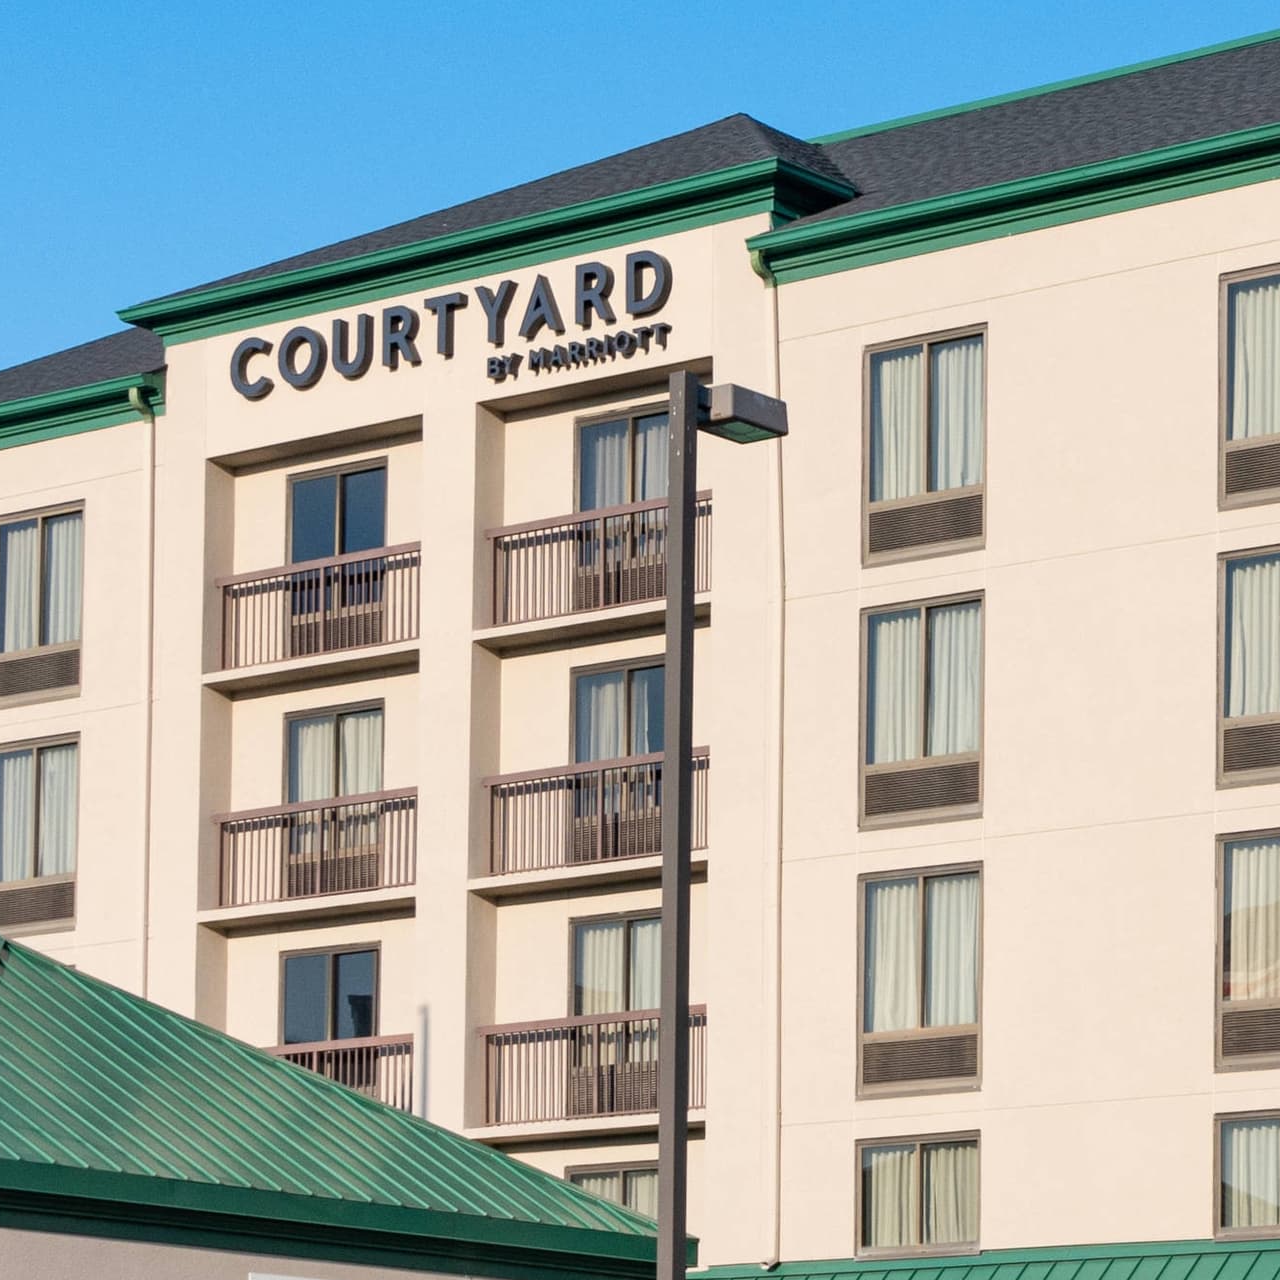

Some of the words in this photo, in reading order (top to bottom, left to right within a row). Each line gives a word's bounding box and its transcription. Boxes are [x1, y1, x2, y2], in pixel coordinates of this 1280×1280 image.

[230, 250, 673, 401] COURTYARD
[487, 353, 523, 383] BY
[528, 322, 672, 376] MARRIOTT
